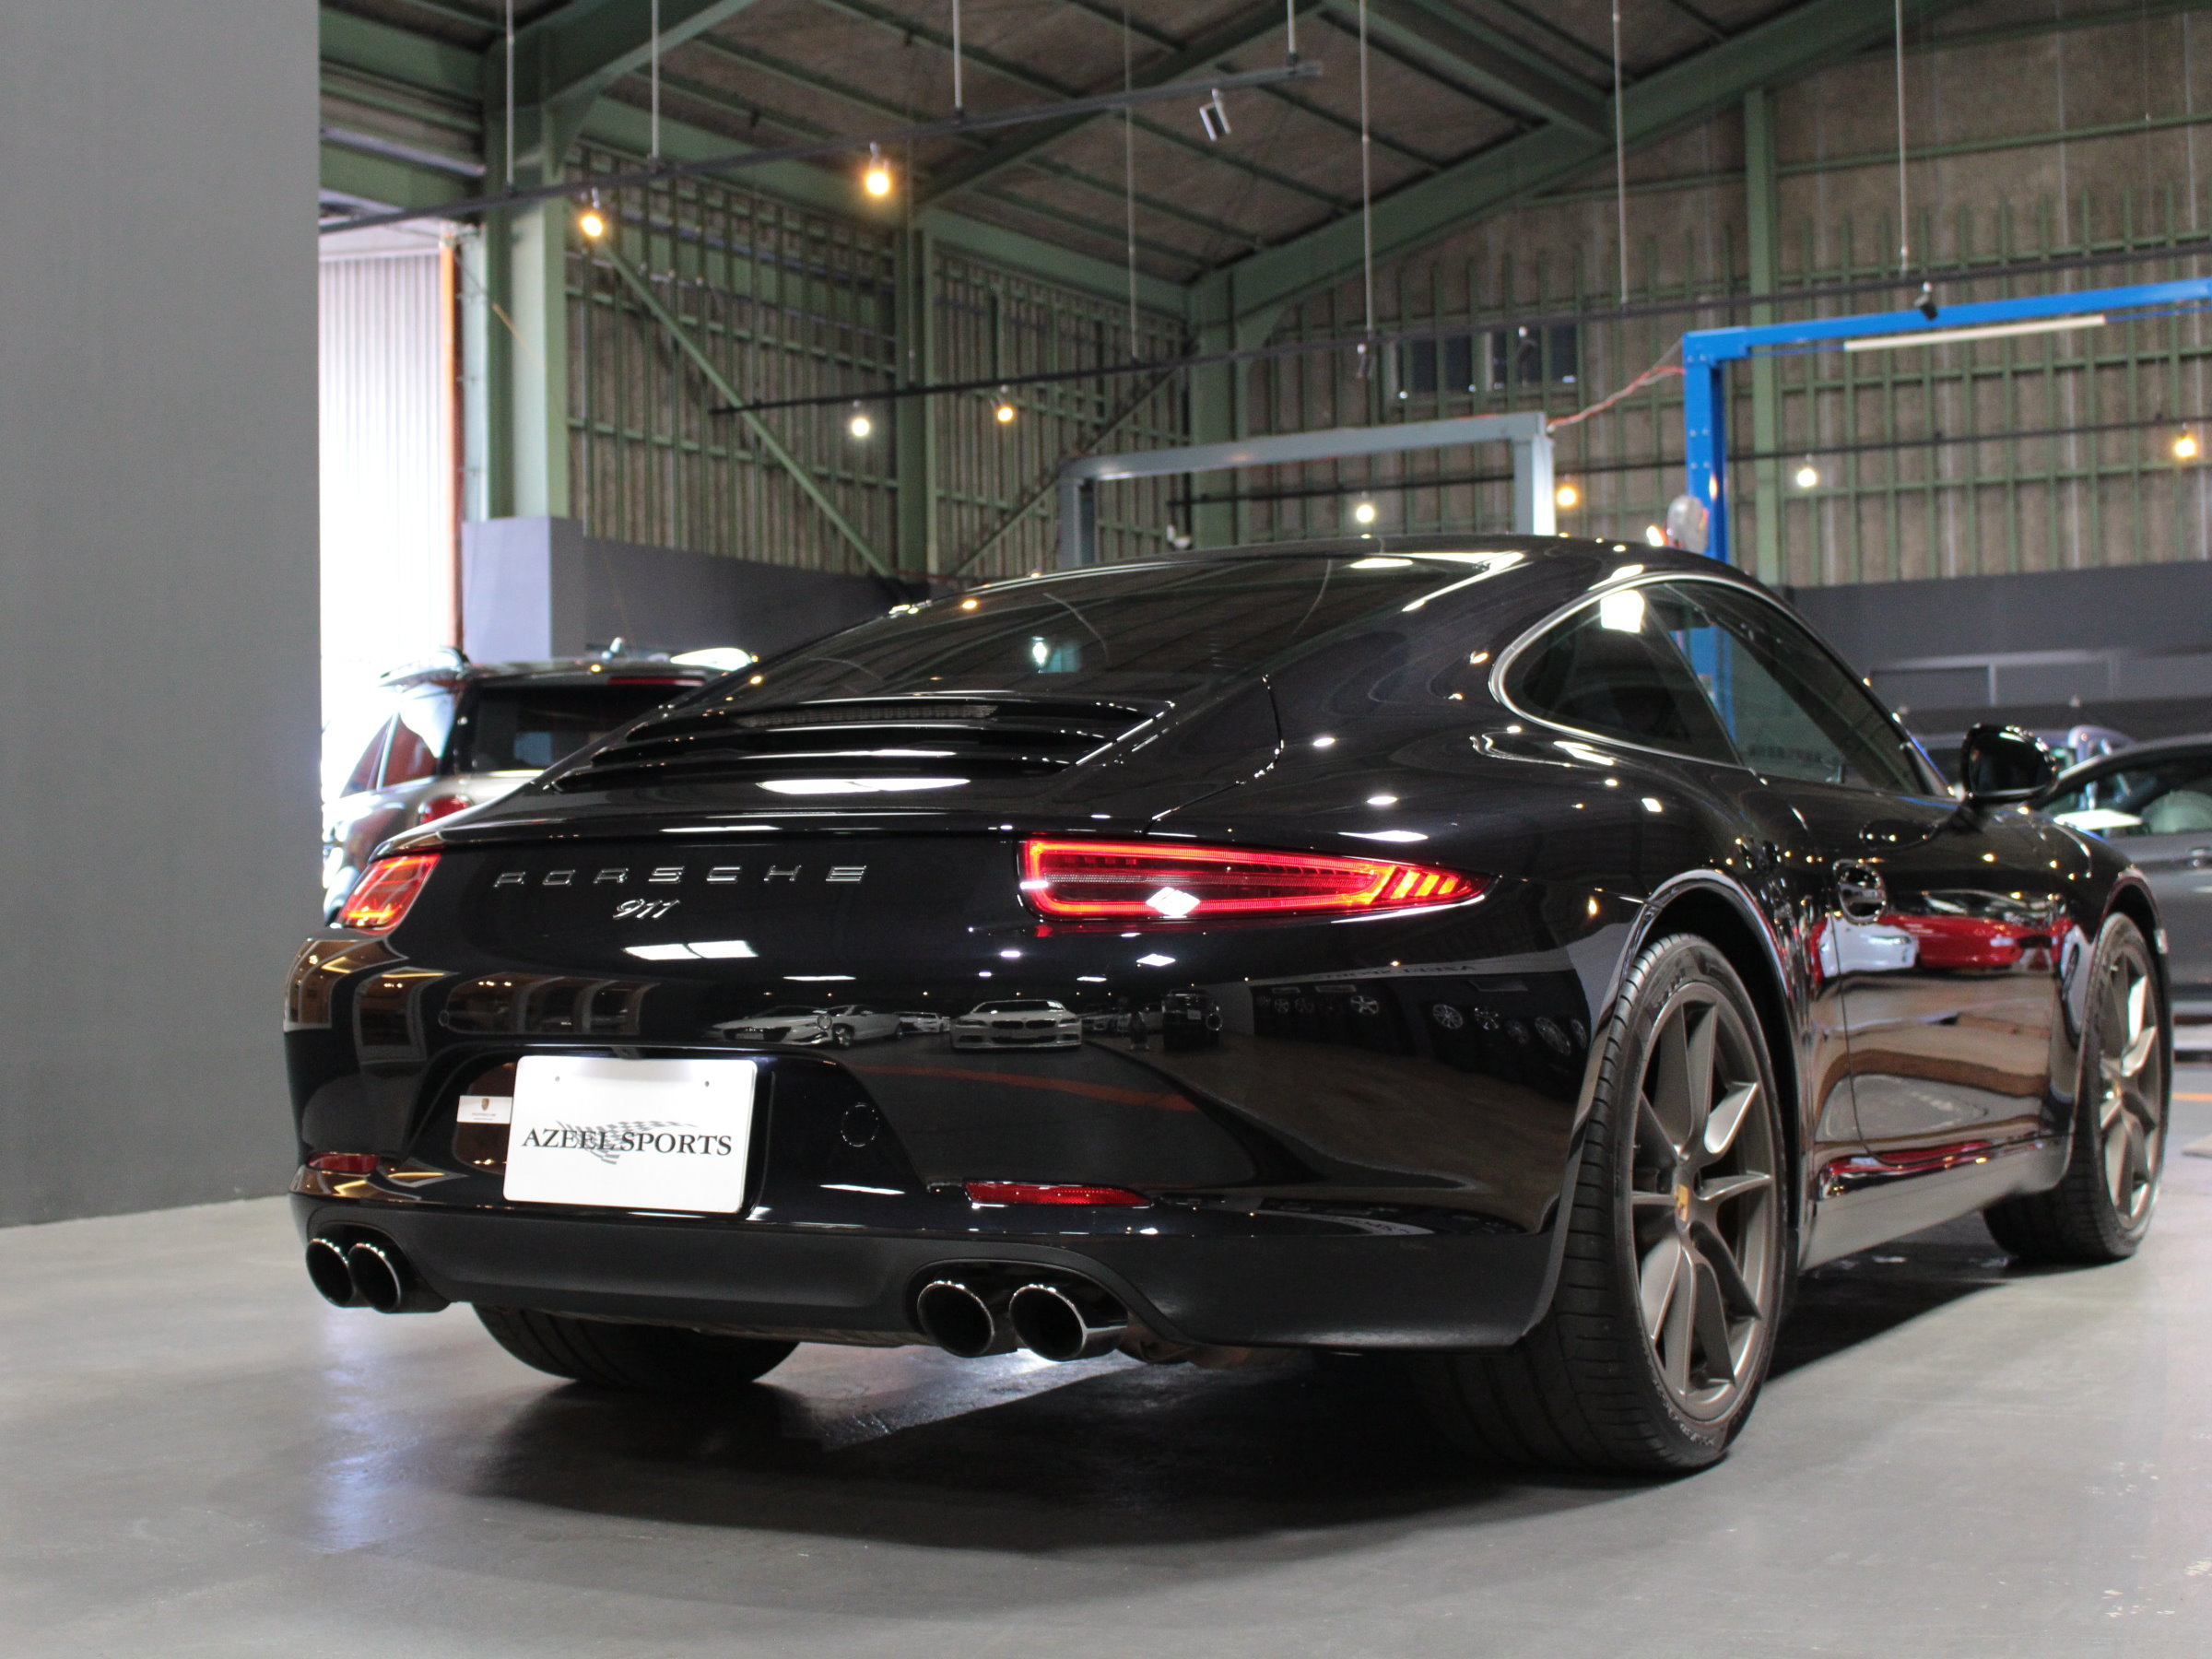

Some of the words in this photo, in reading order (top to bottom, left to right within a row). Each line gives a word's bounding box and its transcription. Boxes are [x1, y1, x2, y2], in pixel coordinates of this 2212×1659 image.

[493, 865, 867, 888] PORSCHE
[613, 898, 681, 920] 911
[522, 1127, 616, 1151] AZEEL
[619, 1131, 732, 1156] SPORTS
